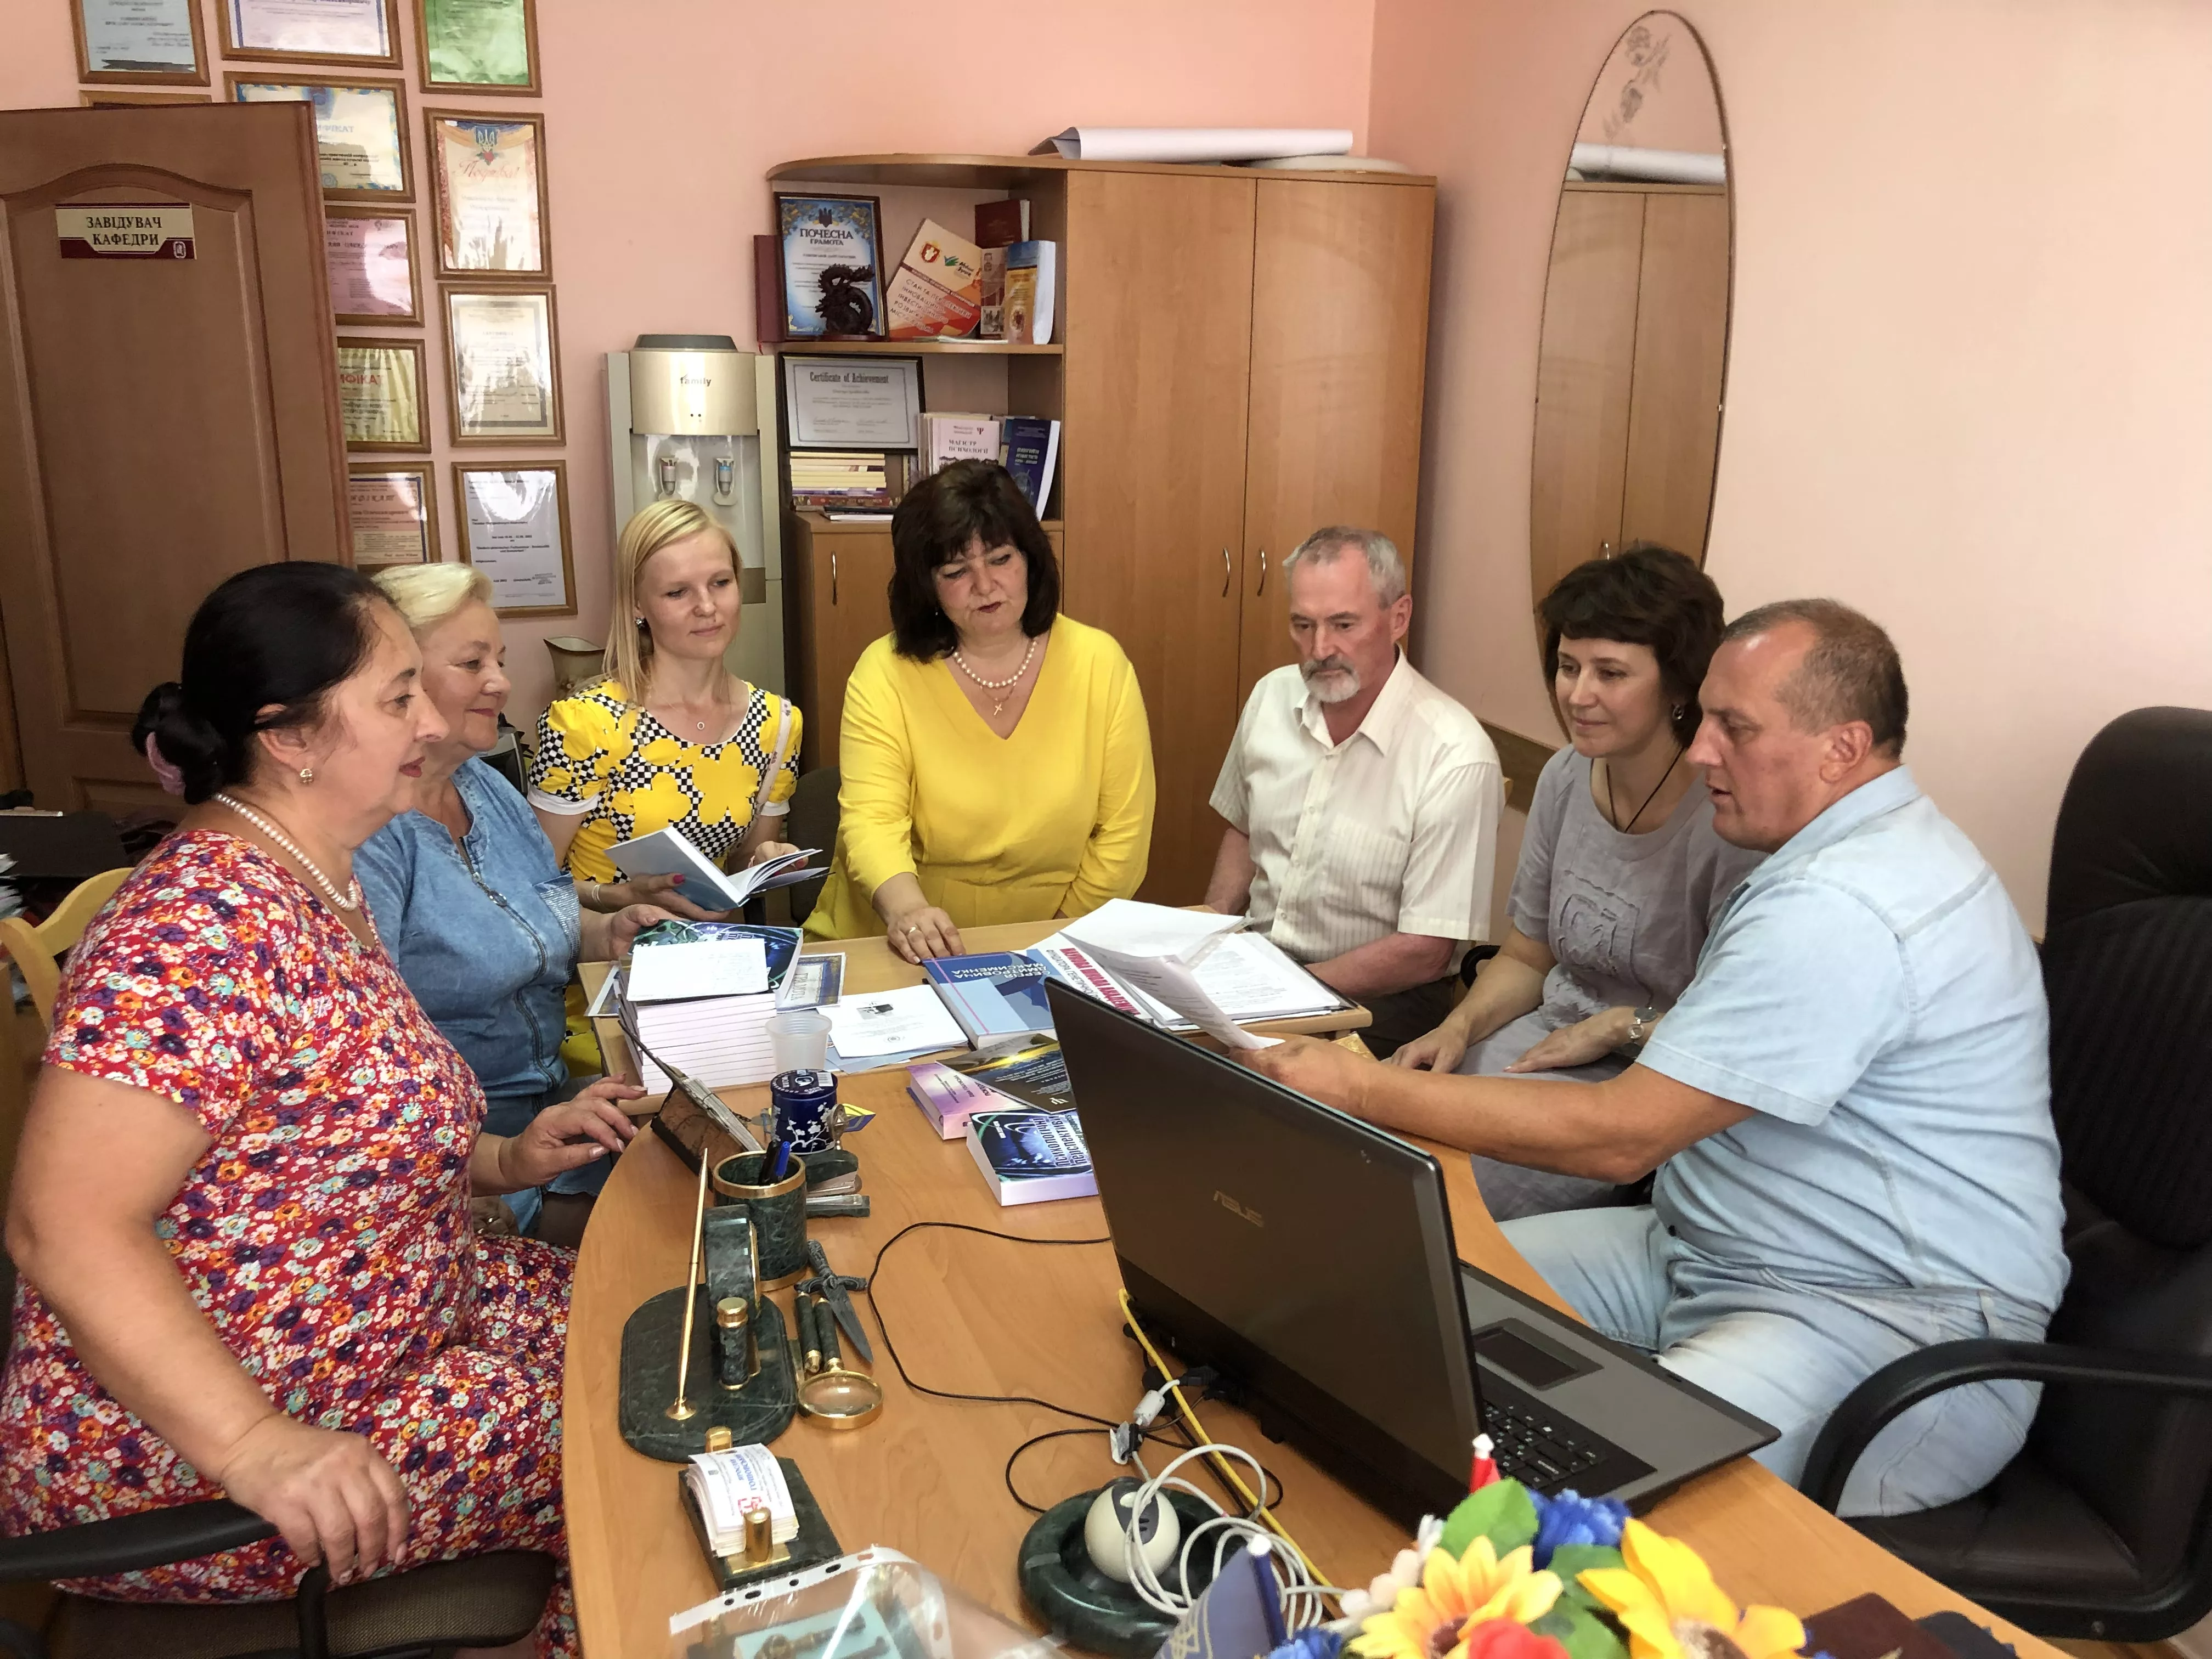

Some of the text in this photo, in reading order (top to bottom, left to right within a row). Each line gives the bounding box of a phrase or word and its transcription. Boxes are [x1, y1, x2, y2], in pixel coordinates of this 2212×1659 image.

[86, 216, 162, 230] ЗАВІДУВАЧ
[92, 233, 160, 246] КАФЕДРИ
[800, 228, 854, 240] ПОЧЕСНА
[680, 373, 712, 387] family
[810, 371, 889, 384] Certificate of Achievement
[948, 446, 989, 454] ПСИХОЛОГІЇ
[951, 962, 1044, 974] МАКСИМЕНКА
[954, 966, 1047, 979] ДМИТРОВИЧА
[1213, 1190, 1265, 1228] ASUS
